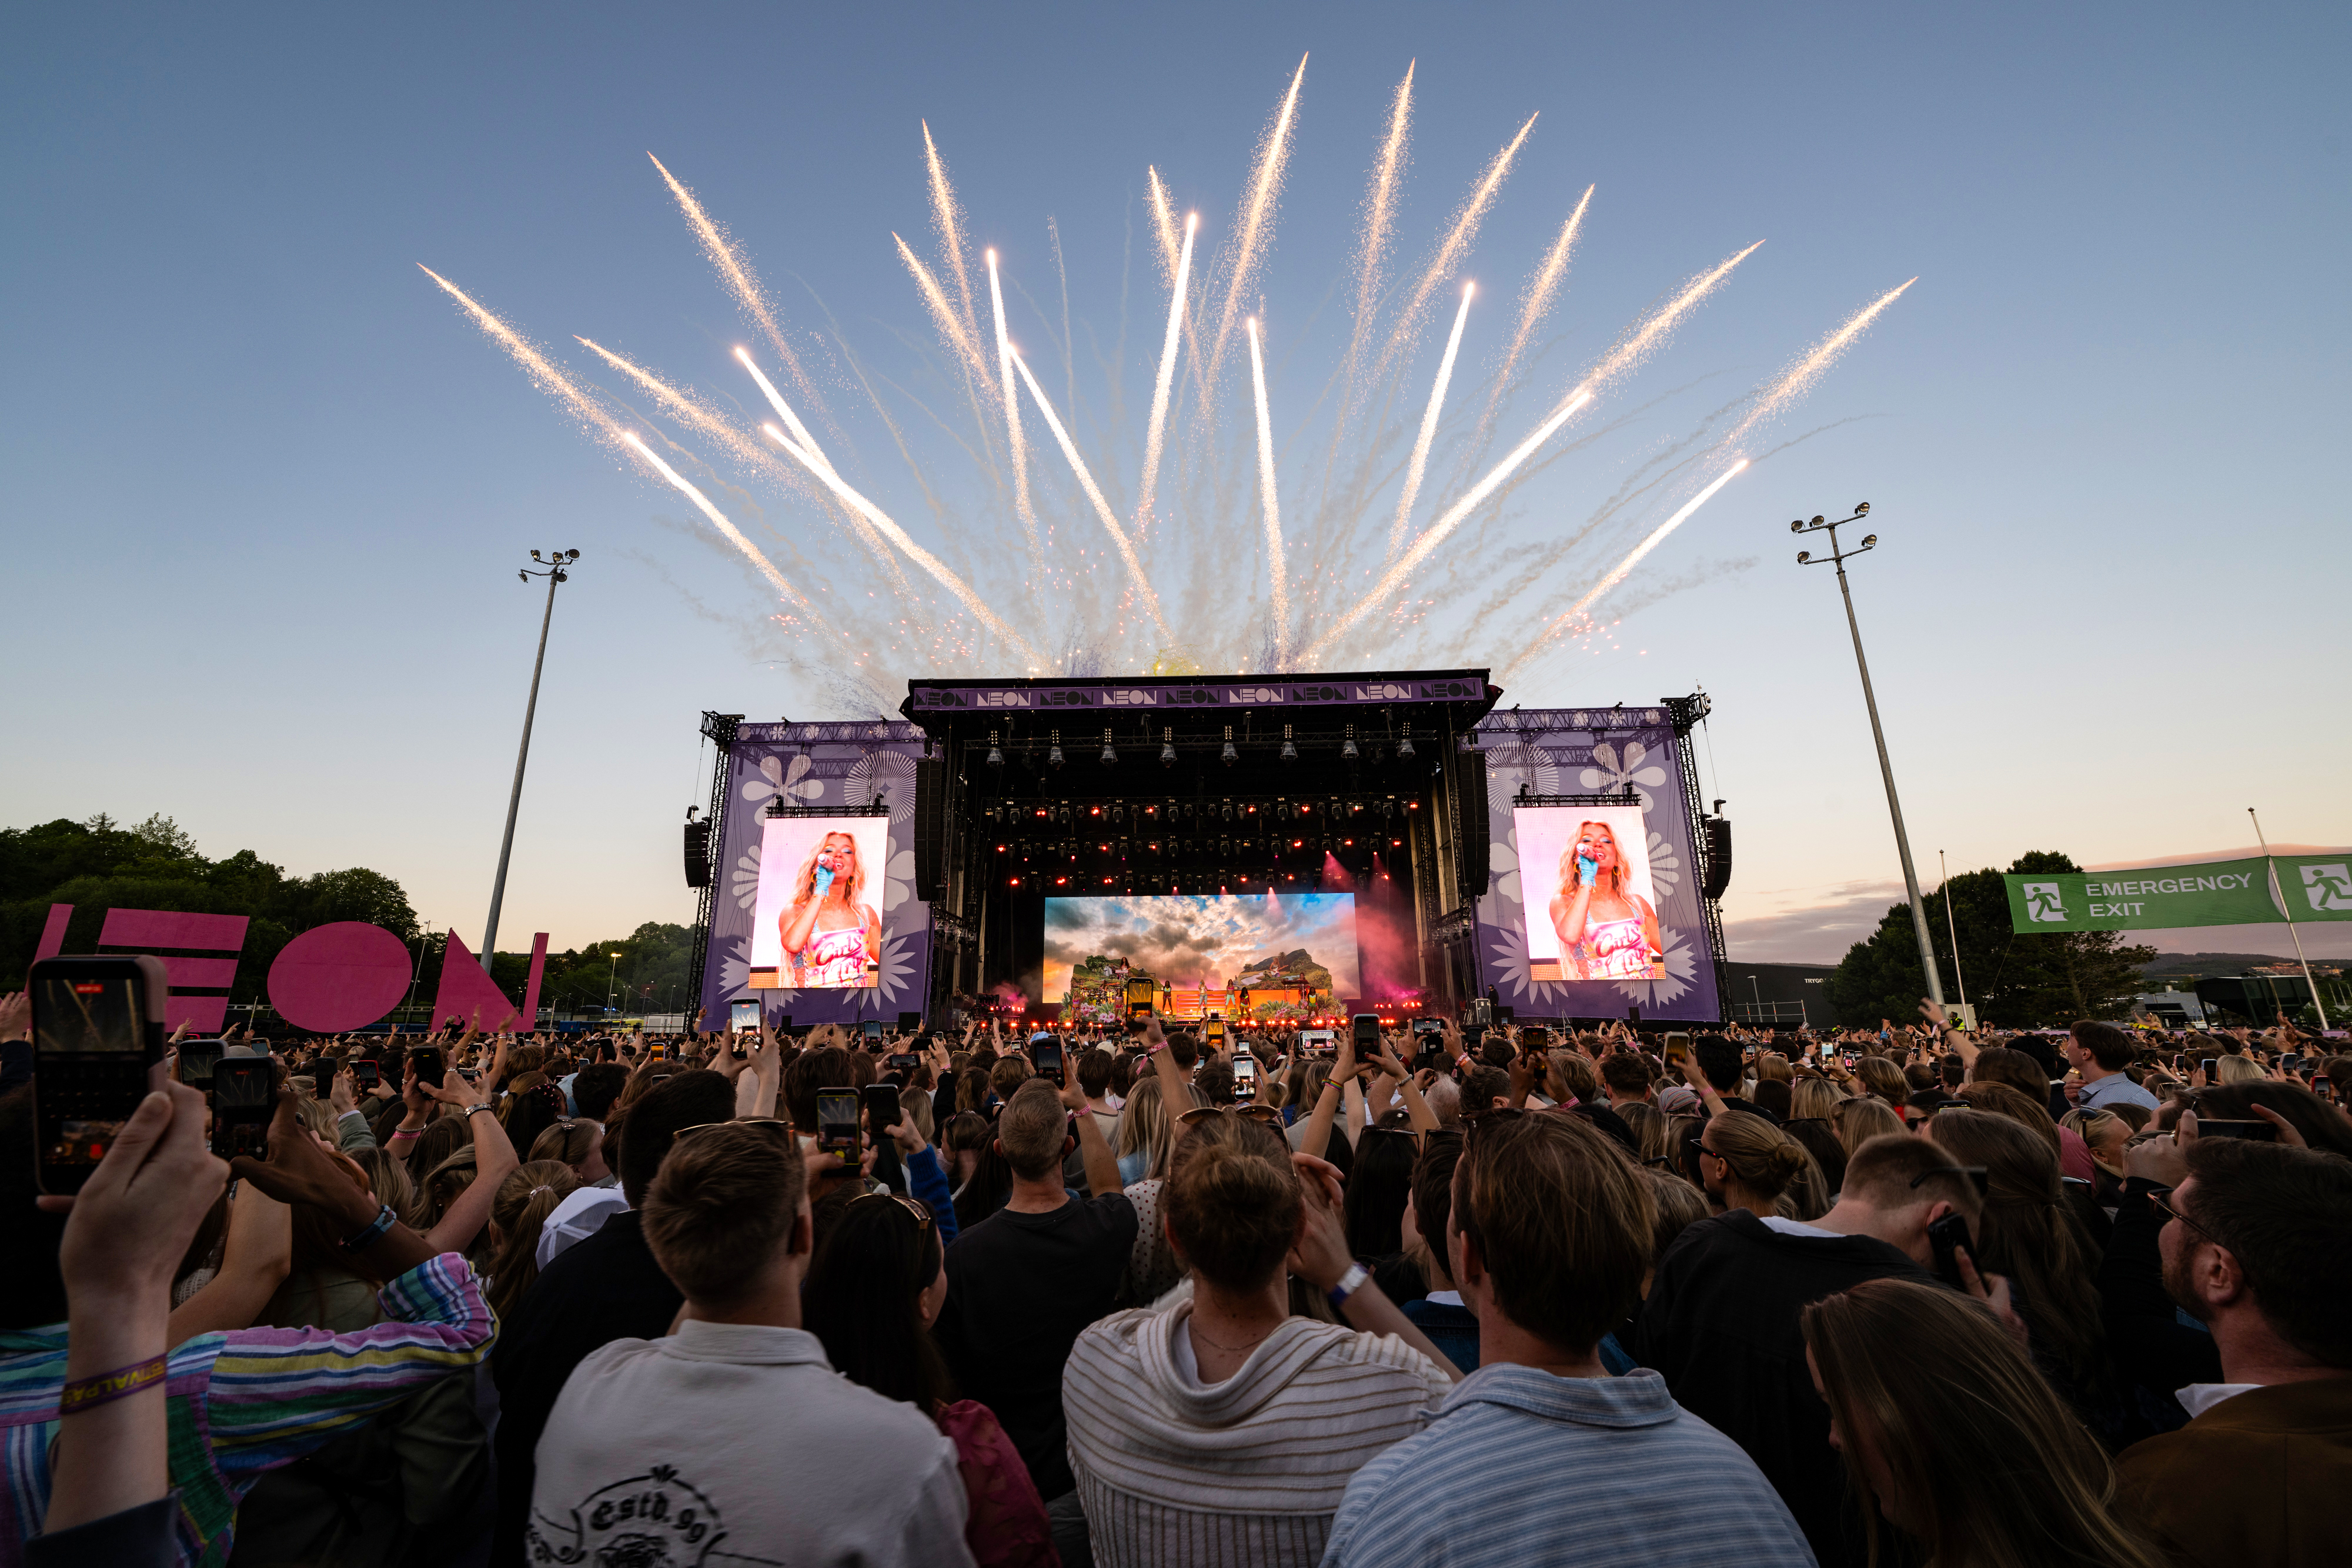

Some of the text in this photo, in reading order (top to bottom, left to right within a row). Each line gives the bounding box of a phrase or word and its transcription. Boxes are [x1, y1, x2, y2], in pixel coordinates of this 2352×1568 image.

[914, 681, 1476, 707] NEON NEON NEON NEON NEON NEON NEON NEON NEON
[2086, 872, 2252, 897] EMERGENCY
[2089, 902, 2145, 918] EXIT
[0, 903, 549, 1034] EON
